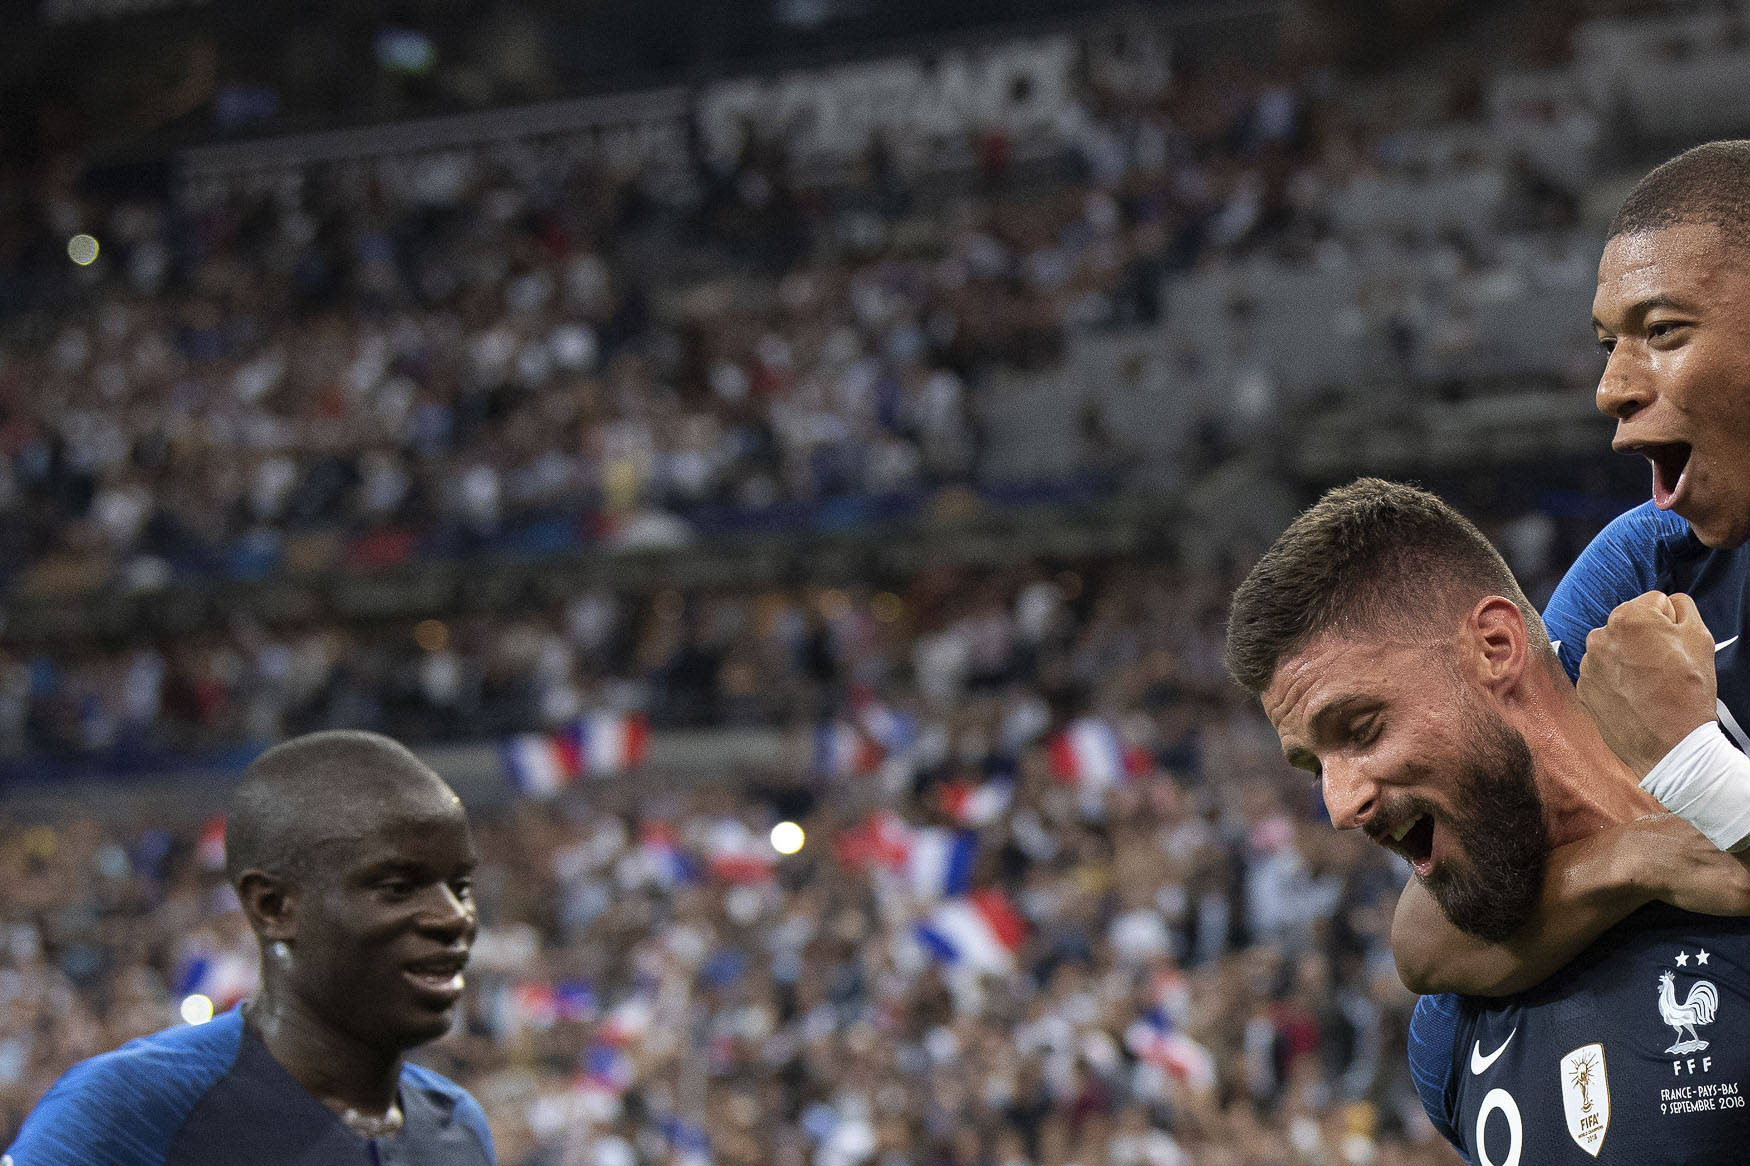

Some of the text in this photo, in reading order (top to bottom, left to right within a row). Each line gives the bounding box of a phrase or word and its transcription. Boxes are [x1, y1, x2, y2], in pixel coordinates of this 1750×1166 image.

[1660, 1096, 1745, 1115] 9 SEPTEMBRE 2018
[1580, 1113, 1599, 1131] FIFA
